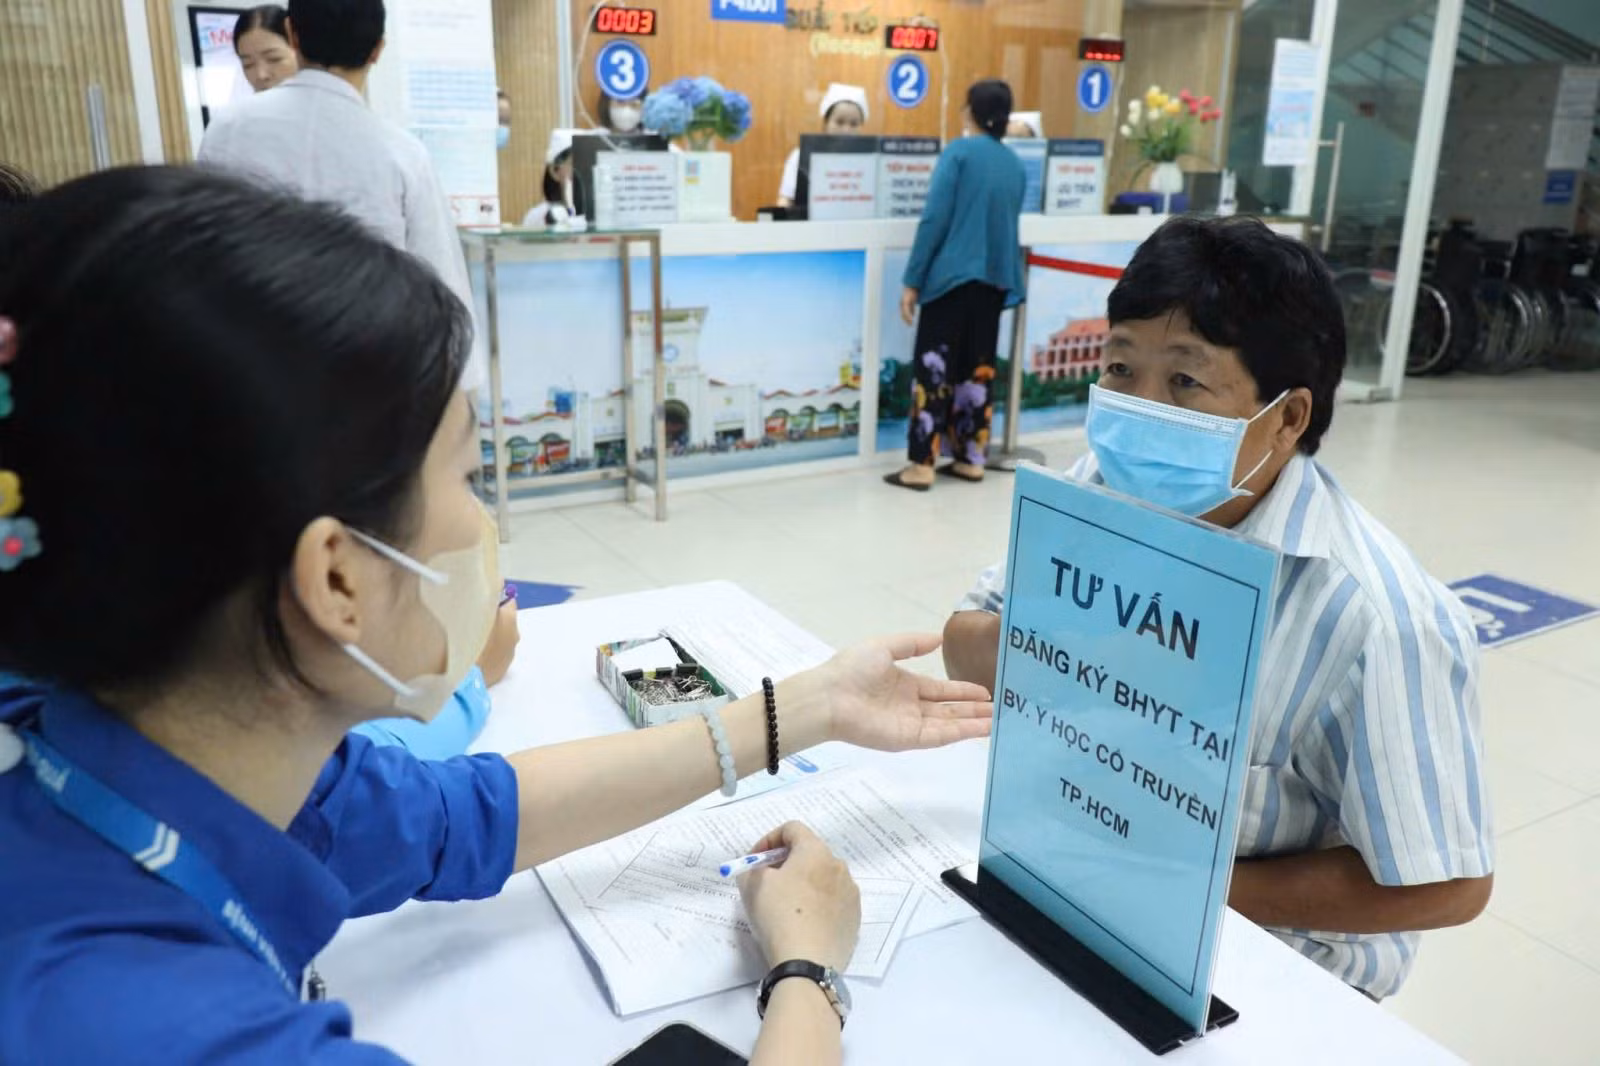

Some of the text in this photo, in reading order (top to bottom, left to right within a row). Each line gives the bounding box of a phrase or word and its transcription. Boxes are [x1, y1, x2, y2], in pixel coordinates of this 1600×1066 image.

[597, 8, 653, 33] 0003
[892, 27, 937, 49] 0007
[610, 49, 636, 91] 3
[897, 64, 919, 99] 2
[1088, 72, 1102, 105] 1
[1051, 557, 1200, 661] TƯ VẤN
[1010, 625, 1229, 762] ĐĂNG KÝ BHYT TẠI
[1003, 687, 1029, 719] BV.
[1036, 705, 1047, 726] Y
[1051, 715, 1091, 752] HỌC
[1059, 777, 1130, 839] TP.HCM
